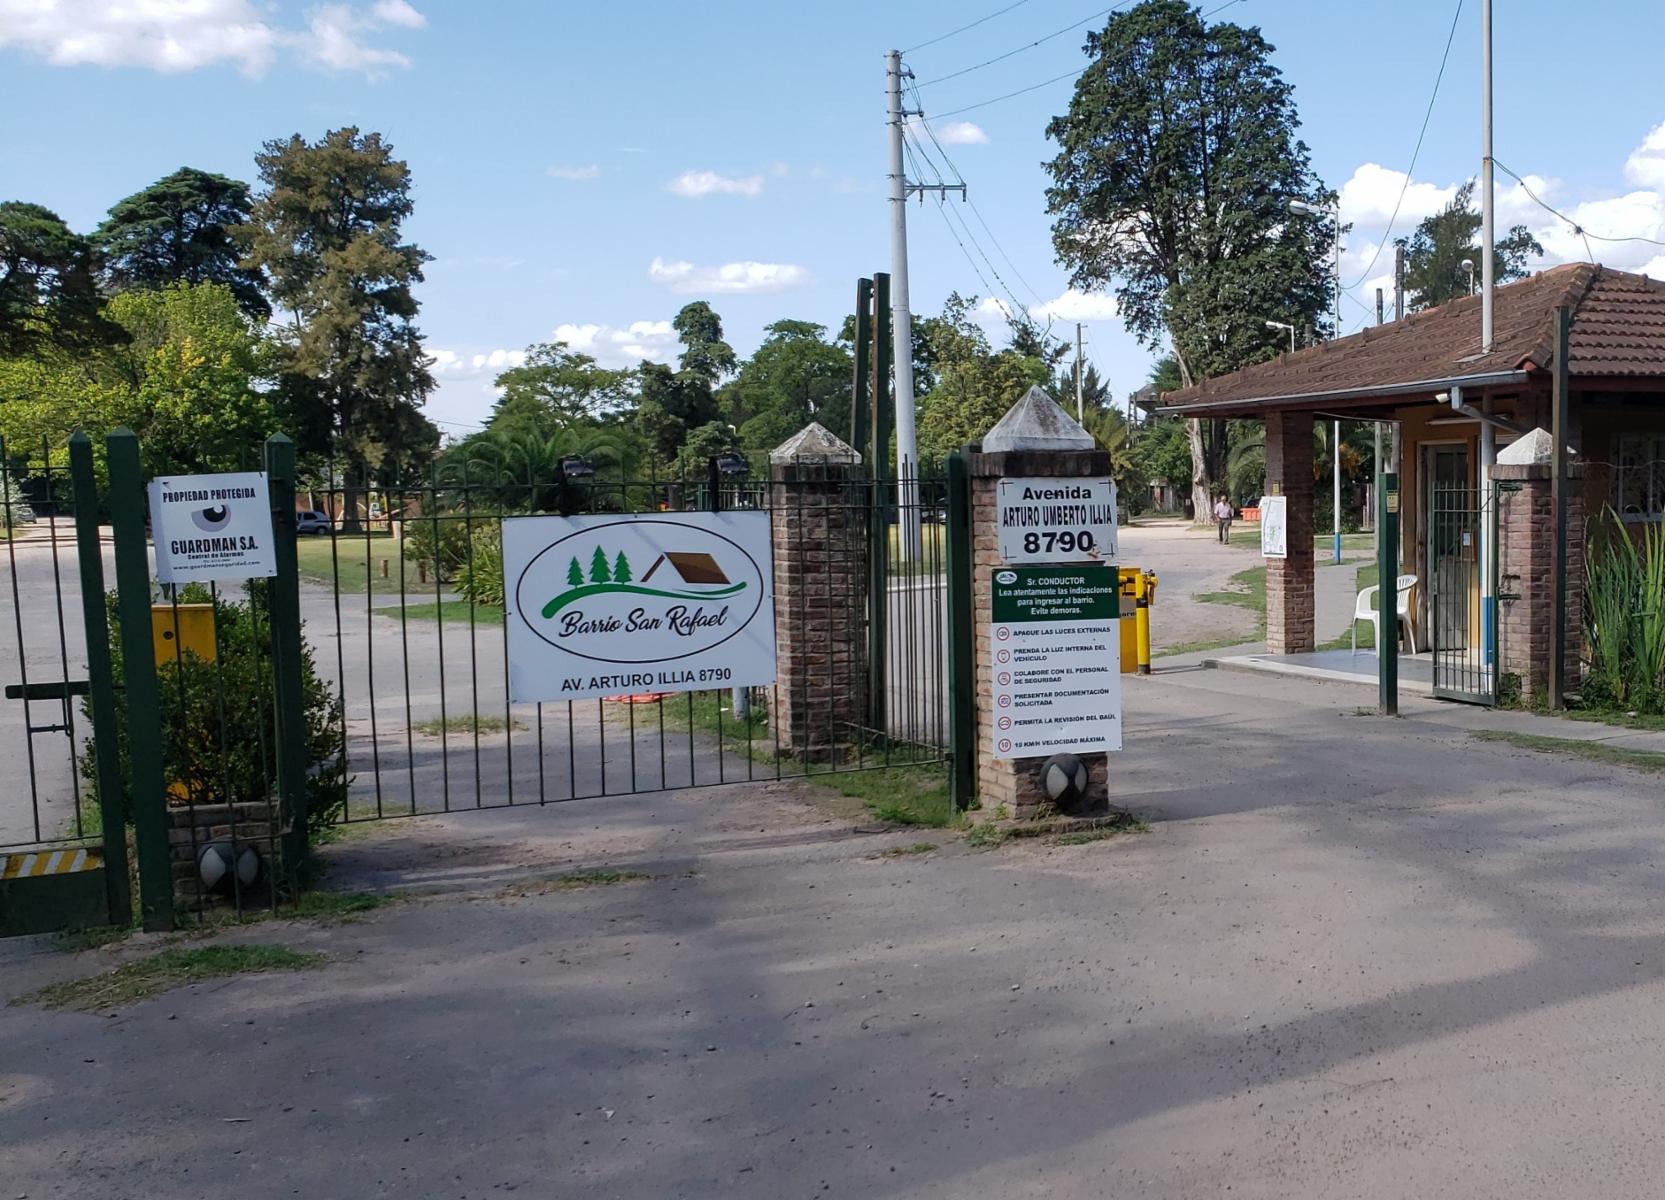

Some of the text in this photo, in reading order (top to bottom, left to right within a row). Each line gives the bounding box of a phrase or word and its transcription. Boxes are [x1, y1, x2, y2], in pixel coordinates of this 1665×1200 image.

[162, 487, 256, 503] PROPIEDAD PROTEGIDA
[1022, 486, 1092, 500] Avenida
[1003, 504, 1112, 527] ARTURO UMBERTO ILLIA
[171, 535, 259, 555] GUARDMAN S.A.
[1023, 531, 1094, 554] 8790
[1038, 577, 1085, 586] CONDUCTOR
[1013, 588, 1056, 596] atentamente
[1069, 586, 1112, 594] indicaciones
[1017, 599, 1034, 607] para
[1034, 598, 1064, 606] ingresar
[1072, 596, 1095, 604] barrio.
[1031, 607, 1048, 615] Evite
[558, 605, 729, 637] Barrio San Rafael
[561, 667, 732, 692] AV. ARTURO ILLIA 8790
[1054, 688, 1109, 697] DOCUMENTACIÓN
[1042, 738, 1078, 746] VELOCIDAD
